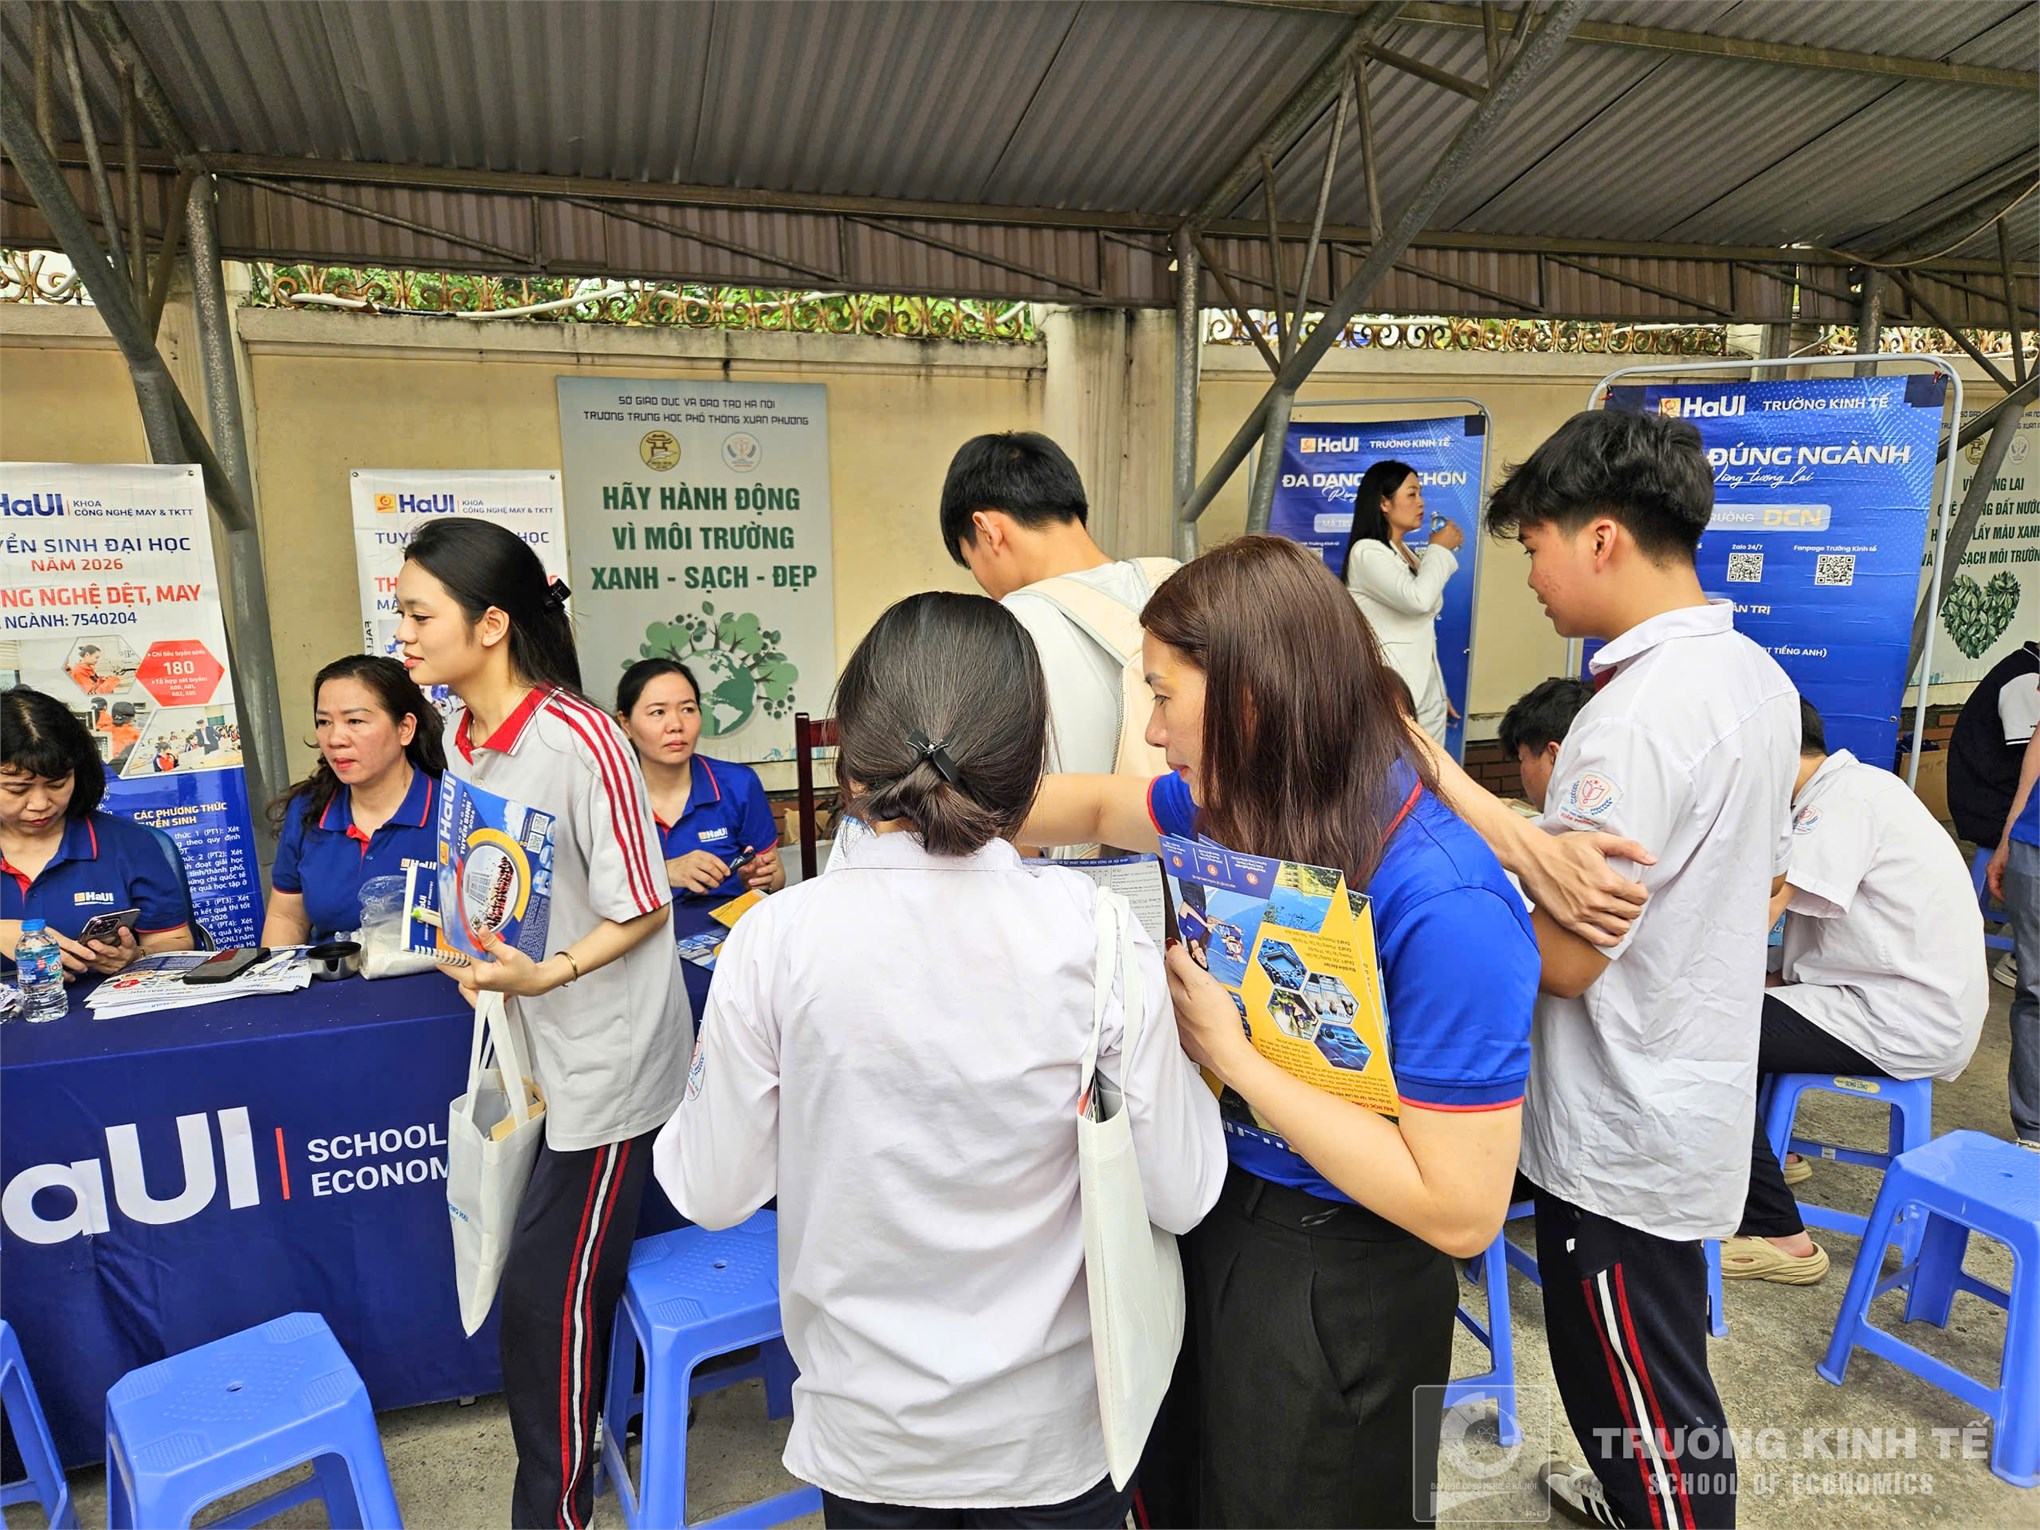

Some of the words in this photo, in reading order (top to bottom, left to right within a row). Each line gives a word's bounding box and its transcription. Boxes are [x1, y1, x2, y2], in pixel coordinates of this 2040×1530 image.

[1683, 395, 1745, 418] HaUI
[1763, 397, 1827, 413] TRƯỜNG
[1829, 397, 1866, 410] KINH
[1868, 393, 1889, 409] TẾ
[627, 412, 660, 422] TRUNG
[1317, 437, 1359, 453] HaUI
[1369, 439, 1411, 449] TRƯỜNG
[1412, 438, 1436, 448] KINH
[1707, 441, 1793, 466] ĐÚNG
[1797, 440, 1911, 466] NGÀNH
[1282, 474, 1310, 488] ĐA
[1789, 465, 1815, 485] lai
[2009, 478, 2025, 491] LAI
[399, 494, 455, 513] HaUI
[602, 482, 652, 511] HÃY
[659, 482, 727, 511] HÀNH
[734, 482, 801, 515] ĐỘNG
[1995, 498, 2013, 516] ĐẤT
[74, 508, 103, 517] CÔNG
[106, 508, 133, 517] NGHỆ
[168, 508, 193, 516] TKTT
[462, 506, 485, 514] CÔNG
[486, 506, 508, 515] NGHỆ
[1711, 510, 1755, 522] RƯỜNG
[1763, 508, 1822, 526] DCN
[612, 521, 636, 550] VÌ
[644, 521, 692, 550] MÔI
[699, 521, 795, 550] TRƯỜNG
[1972, 522, 1991, 541] LẤY
[1992, 524, 2015, 540] MÀU
[44, 538, 98, 553] SINH
[105, 537, 141, 555] ĐẠI
[149, 537, 191, 554] HỌC
[31, 556, 76, 572] NĂM
[81, 558, 123, 571] 2026
[1960, 552, 1987, 568] SẠCH
[1989, 548, 2009, 564] MÔI
[2010, 545, 2040, 563] TRƯỜN
[591, 566, 659, 590] XANH
[684, 565, 749, 593] SẠCH
[772, 565, 818, 592] ĐẸP
[40, 583, 101, 609] NGHỆ
[106, 582, 151, 608] DỆT,
[156, 584, 201, 602] MAY
[5, 612, 69, 630] NGÀNH:
[71, 611, 137, 626] 7540204
[1774, 645, 1800, 656] TIẾNG
[1801, 648, 1827, 658] ANH)
[163, 660, 195, 675] 180
[134, 809, 154, 820] CÁC
[156, 805, 199, 818] PHƯƠNG
[200, 801, 227, 813] THỨC
[441, 775, 457, 841] HaUI
[172, 816, 197, 827] SINH
[85, 892, 114, 902] HaUI
[237, 894, 249, 902] Xét
[211, 914, 228, 922] 2026
[307, 1123, 447, 1163] SCHOOL
[0, 1106, 260, 1244] aUI
[311, 1156, 449, 1197] ECONOM
